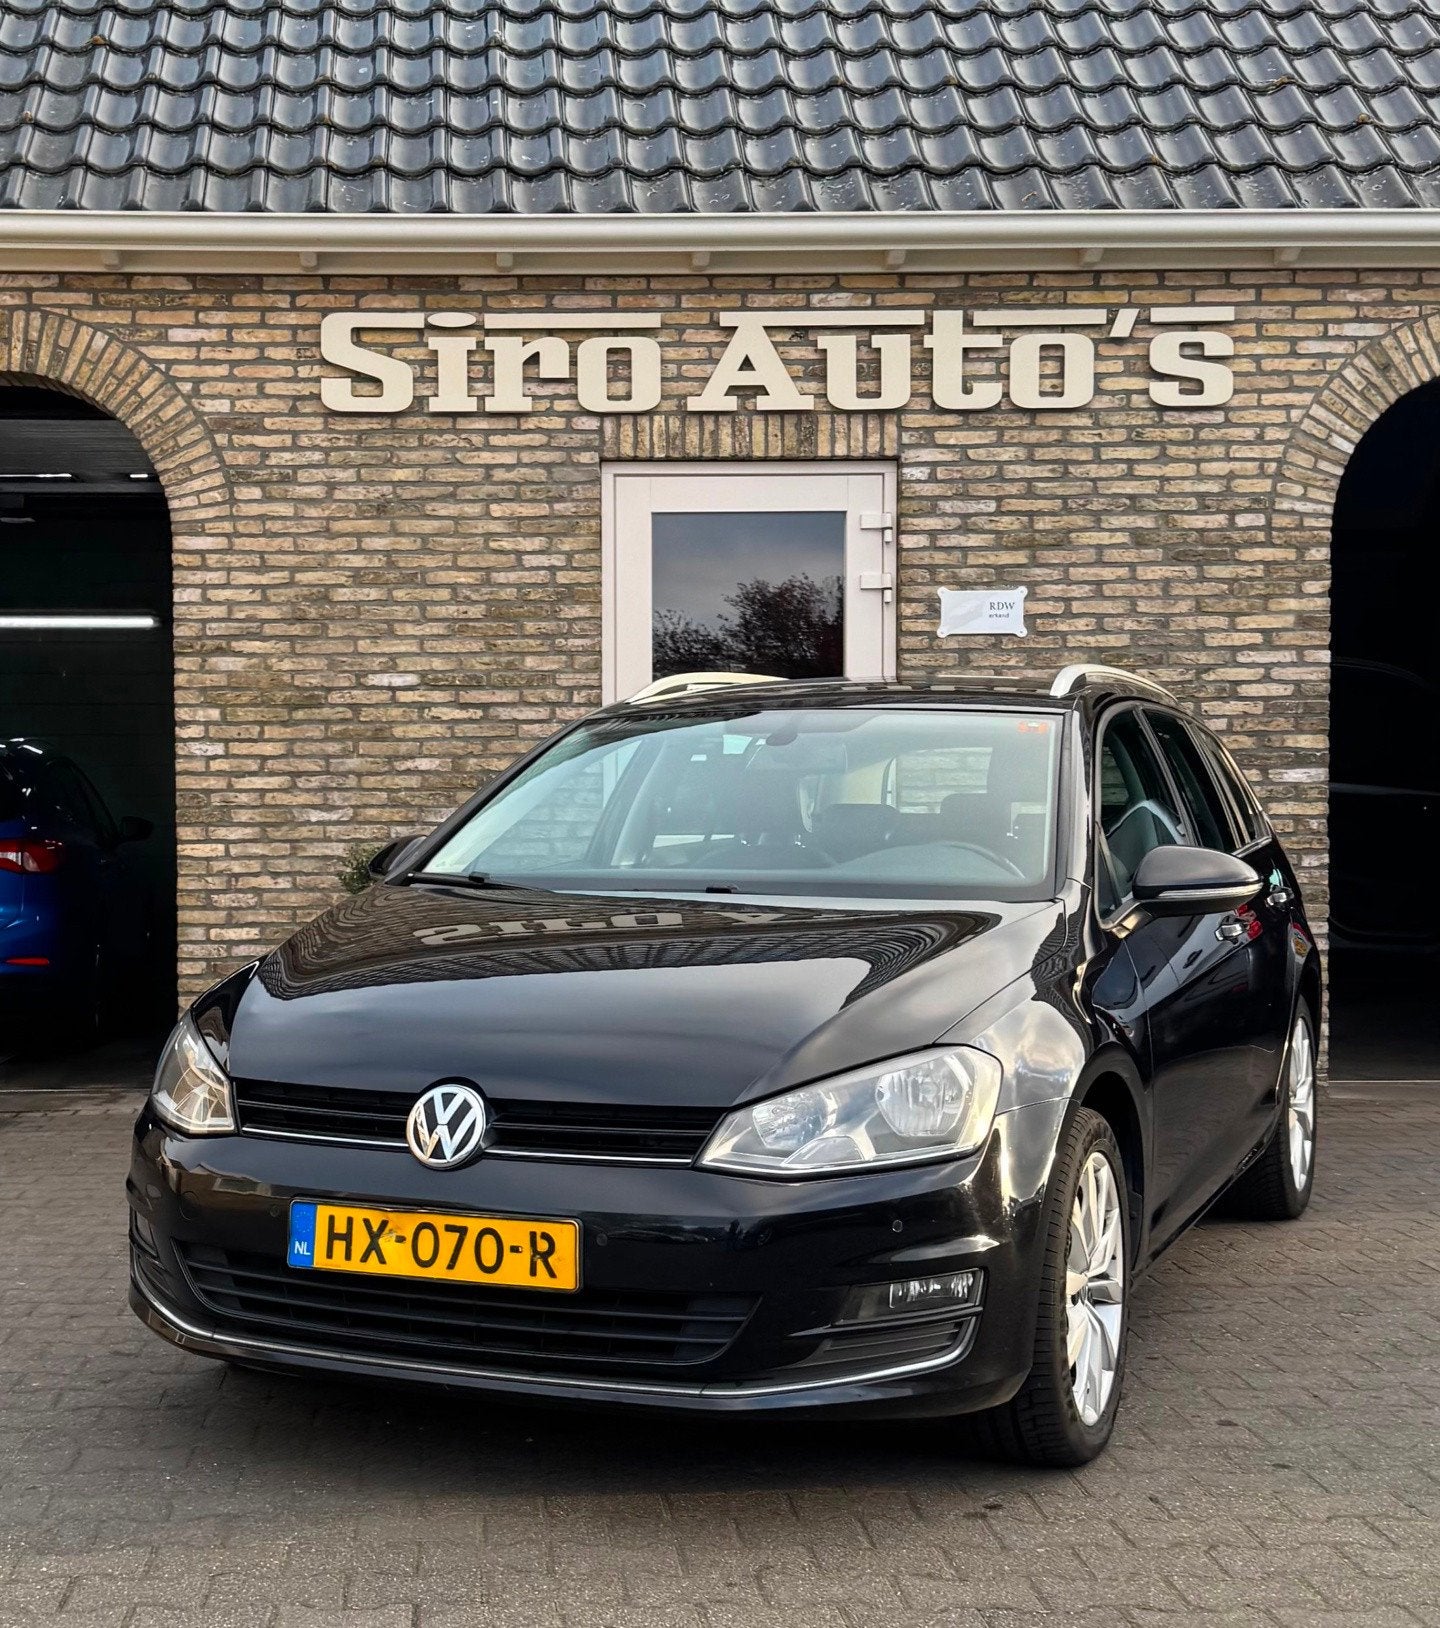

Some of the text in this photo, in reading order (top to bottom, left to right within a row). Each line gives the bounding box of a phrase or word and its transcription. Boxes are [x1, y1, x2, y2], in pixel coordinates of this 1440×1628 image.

[320, 307, 1236, 414] Siro Auto's
[989, 601, 1016, 611] RDW
[410, 1086, 484, 1166] VW
[294, 1214, 557, 1279] NL HX-070-R
